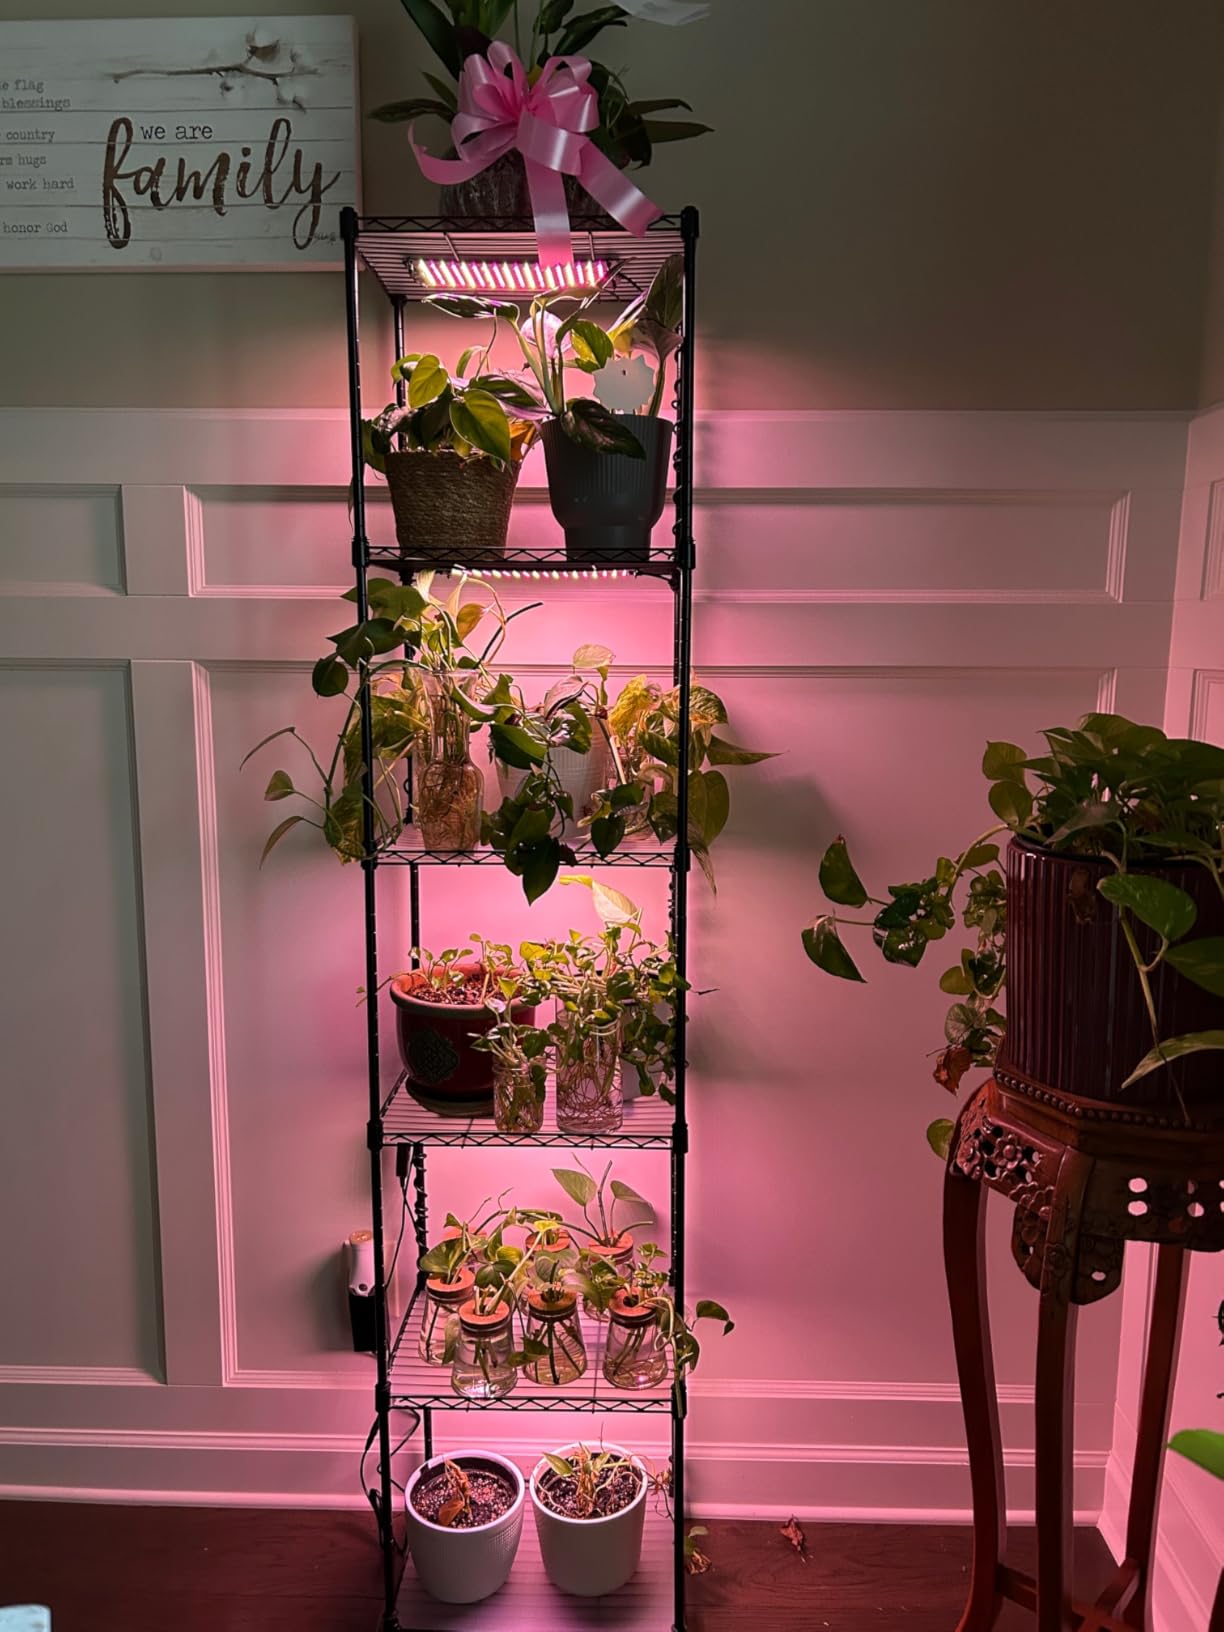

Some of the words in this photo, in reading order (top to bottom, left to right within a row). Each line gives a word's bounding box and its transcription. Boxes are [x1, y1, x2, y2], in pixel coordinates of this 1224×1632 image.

[2, 96, 71, 112] blessings
[6, 128, 55, 144] country
[140, 124, 166, 140] we
[175, 125, 214, 140] are
[17, 153, 47, 169] hugs
[6, 178, 38, 190] work
[42, 177, 75, 189] hard
[103, 117, 341, 250] family
[2, 221, 42, 233] honor
[46, 221, 68, 233] God
